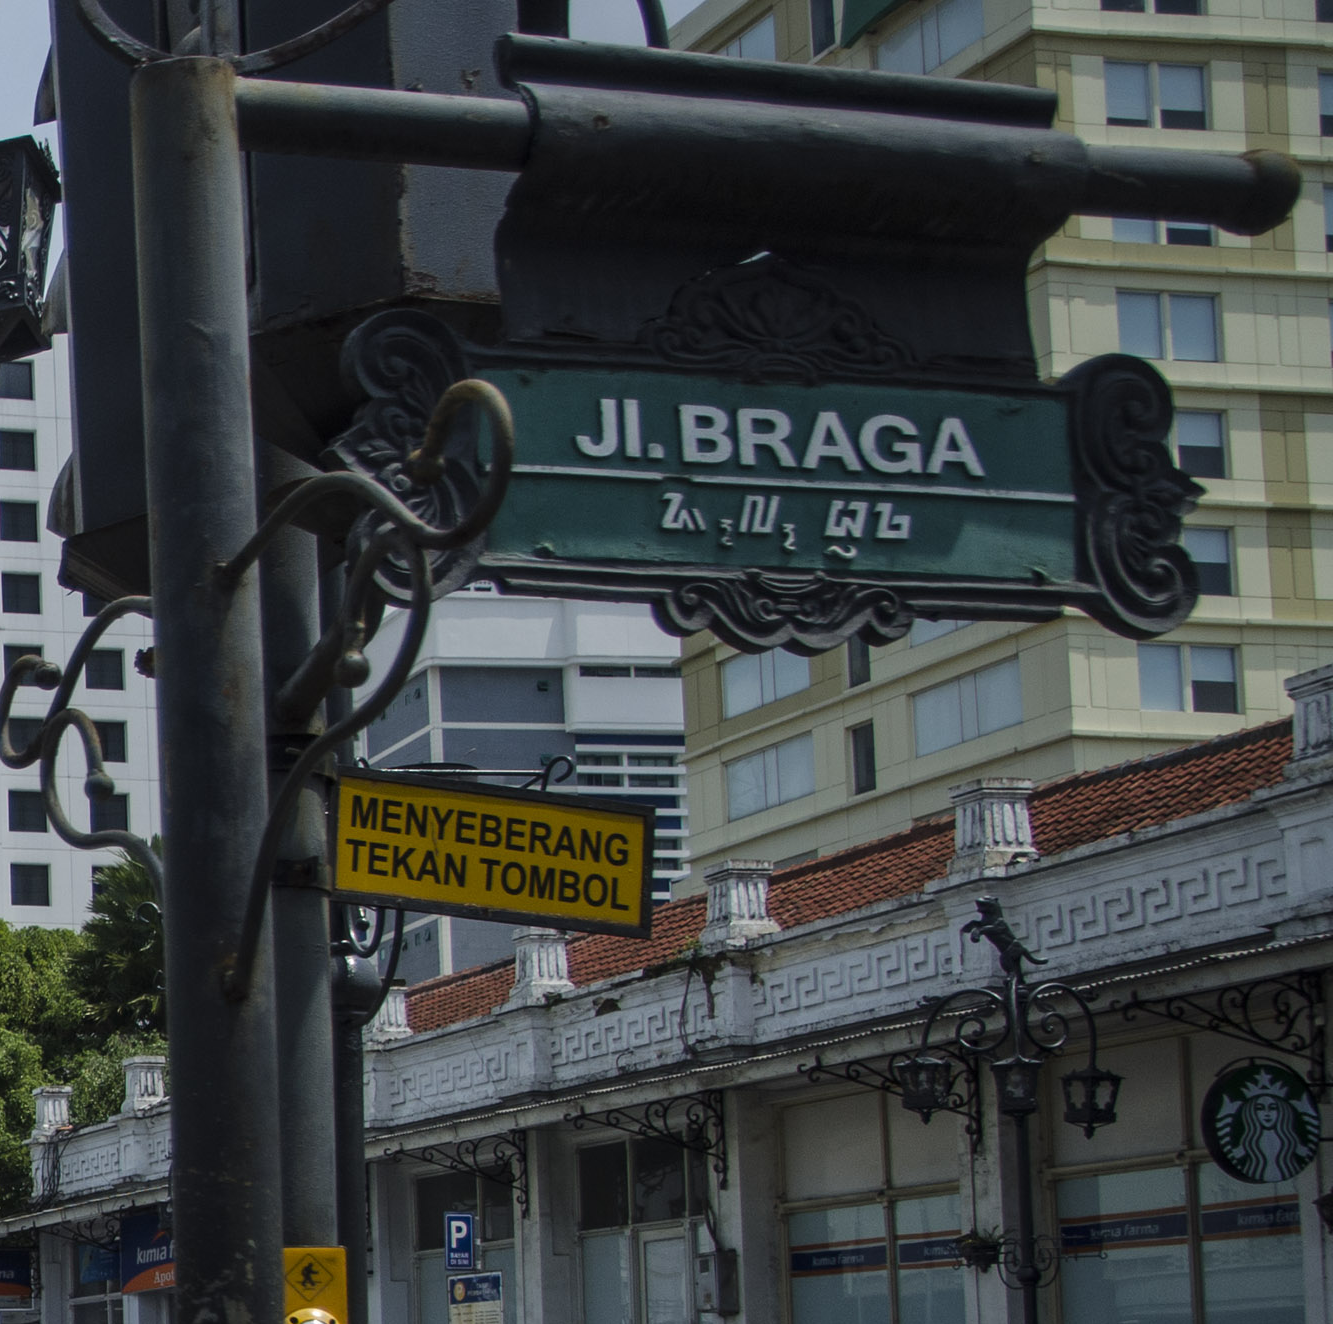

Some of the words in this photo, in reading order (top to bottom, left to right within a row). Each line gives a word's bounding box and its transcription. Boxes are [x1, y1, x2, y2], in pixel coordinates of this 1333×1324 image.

[678, 403, 986, 478] BRAGA
[350, 794, 630, 868] MENYEBERANG
[345, 838, 468, 888] TEKAN
[479, 857, 630, 911] TOMBOL
[136, 1246, 167, 1265] kimia
[450, 1220, 467, 1249] P
